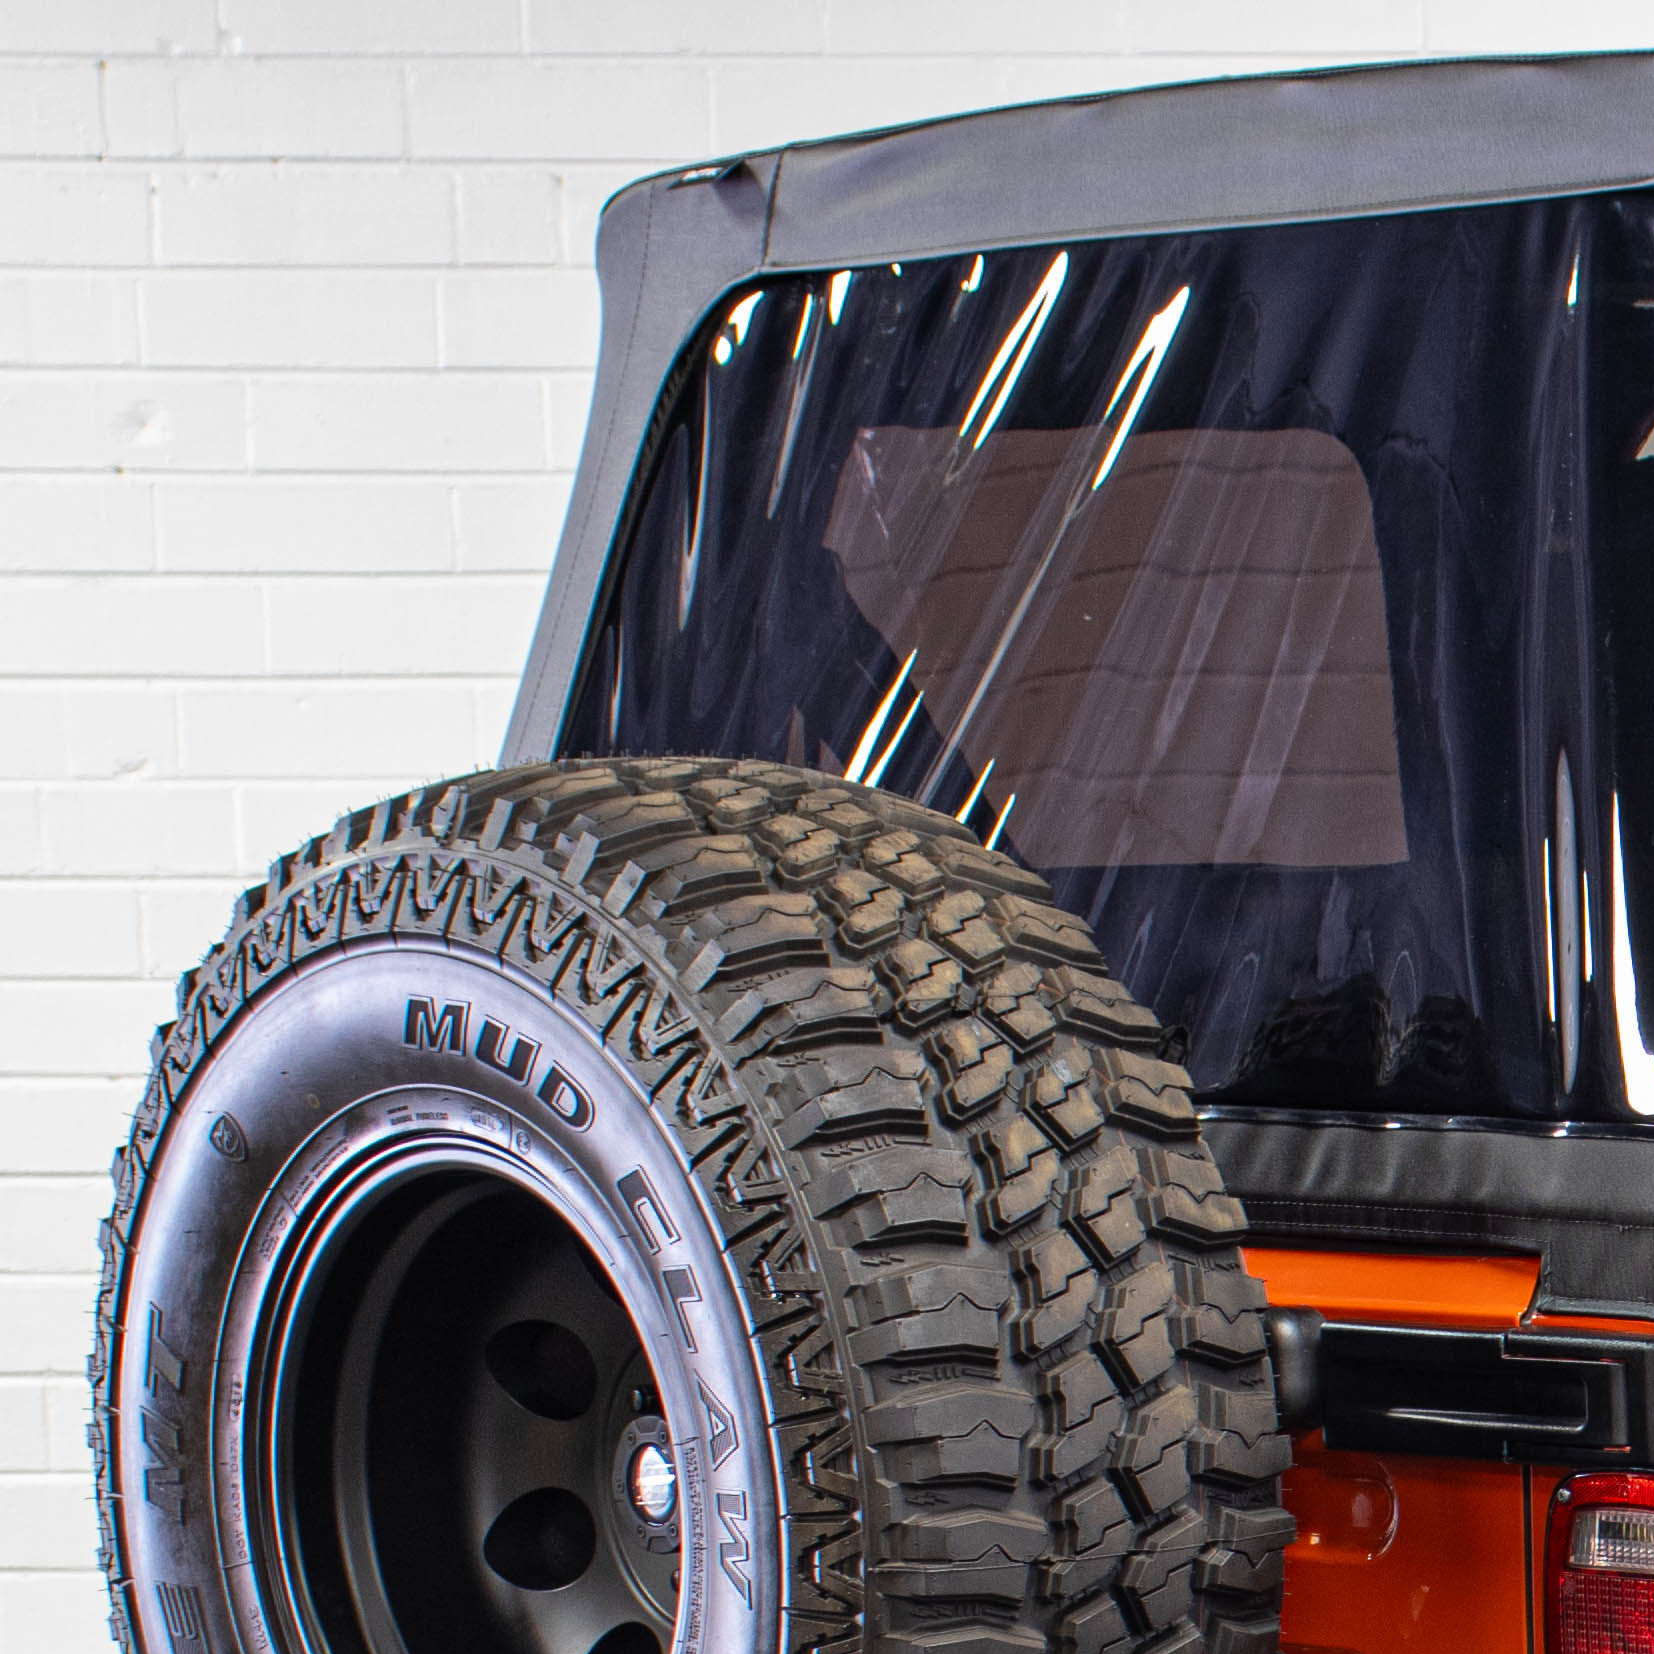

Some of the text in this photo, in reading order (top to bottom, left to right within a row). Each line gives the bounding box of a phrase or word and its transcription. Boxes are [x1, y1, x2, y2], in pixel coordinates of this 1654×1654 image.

[139, 1301, 188, 1526] MT
[402, 994, 595, 1133] MUD
[616, 1164, 753, 1611] CLAW
